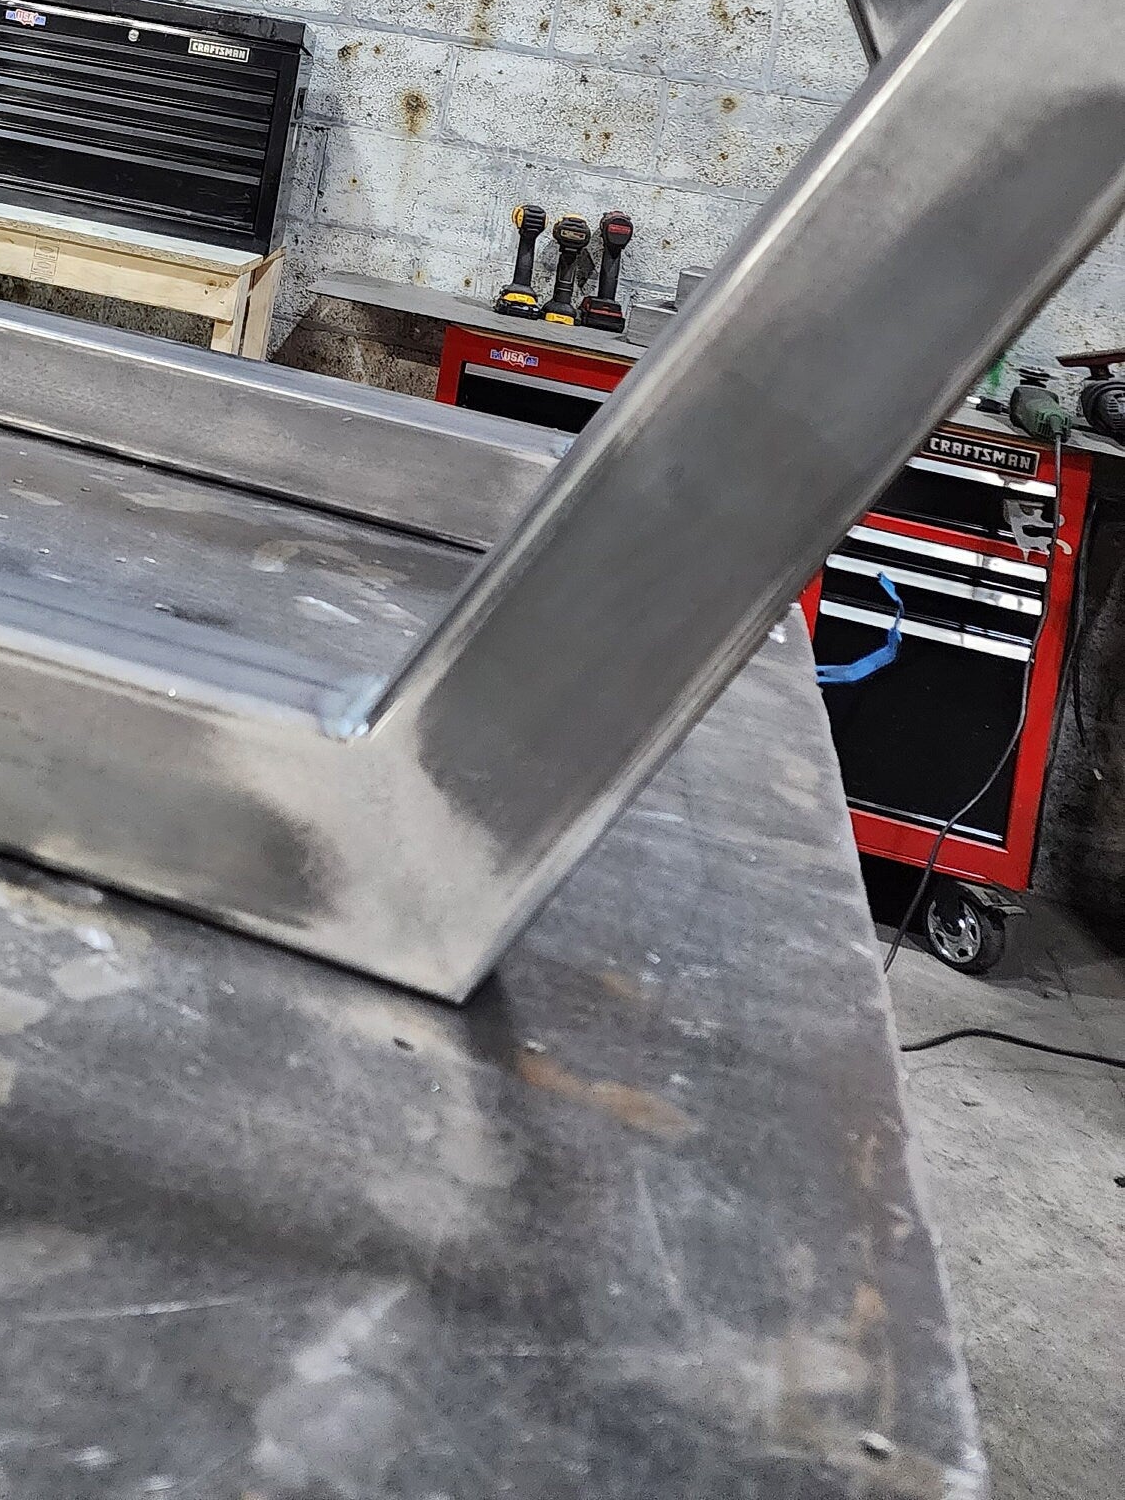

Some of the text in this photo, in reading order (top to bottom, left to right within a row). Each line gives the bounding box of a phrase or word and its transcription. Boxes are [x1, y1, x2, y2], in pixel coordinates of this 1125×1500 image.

[192, 42, 246, 59] CRAFTSMAN
[503, 350, 525, 364] USA
[930, 437, 1032, 470] CRAFTSMAN
